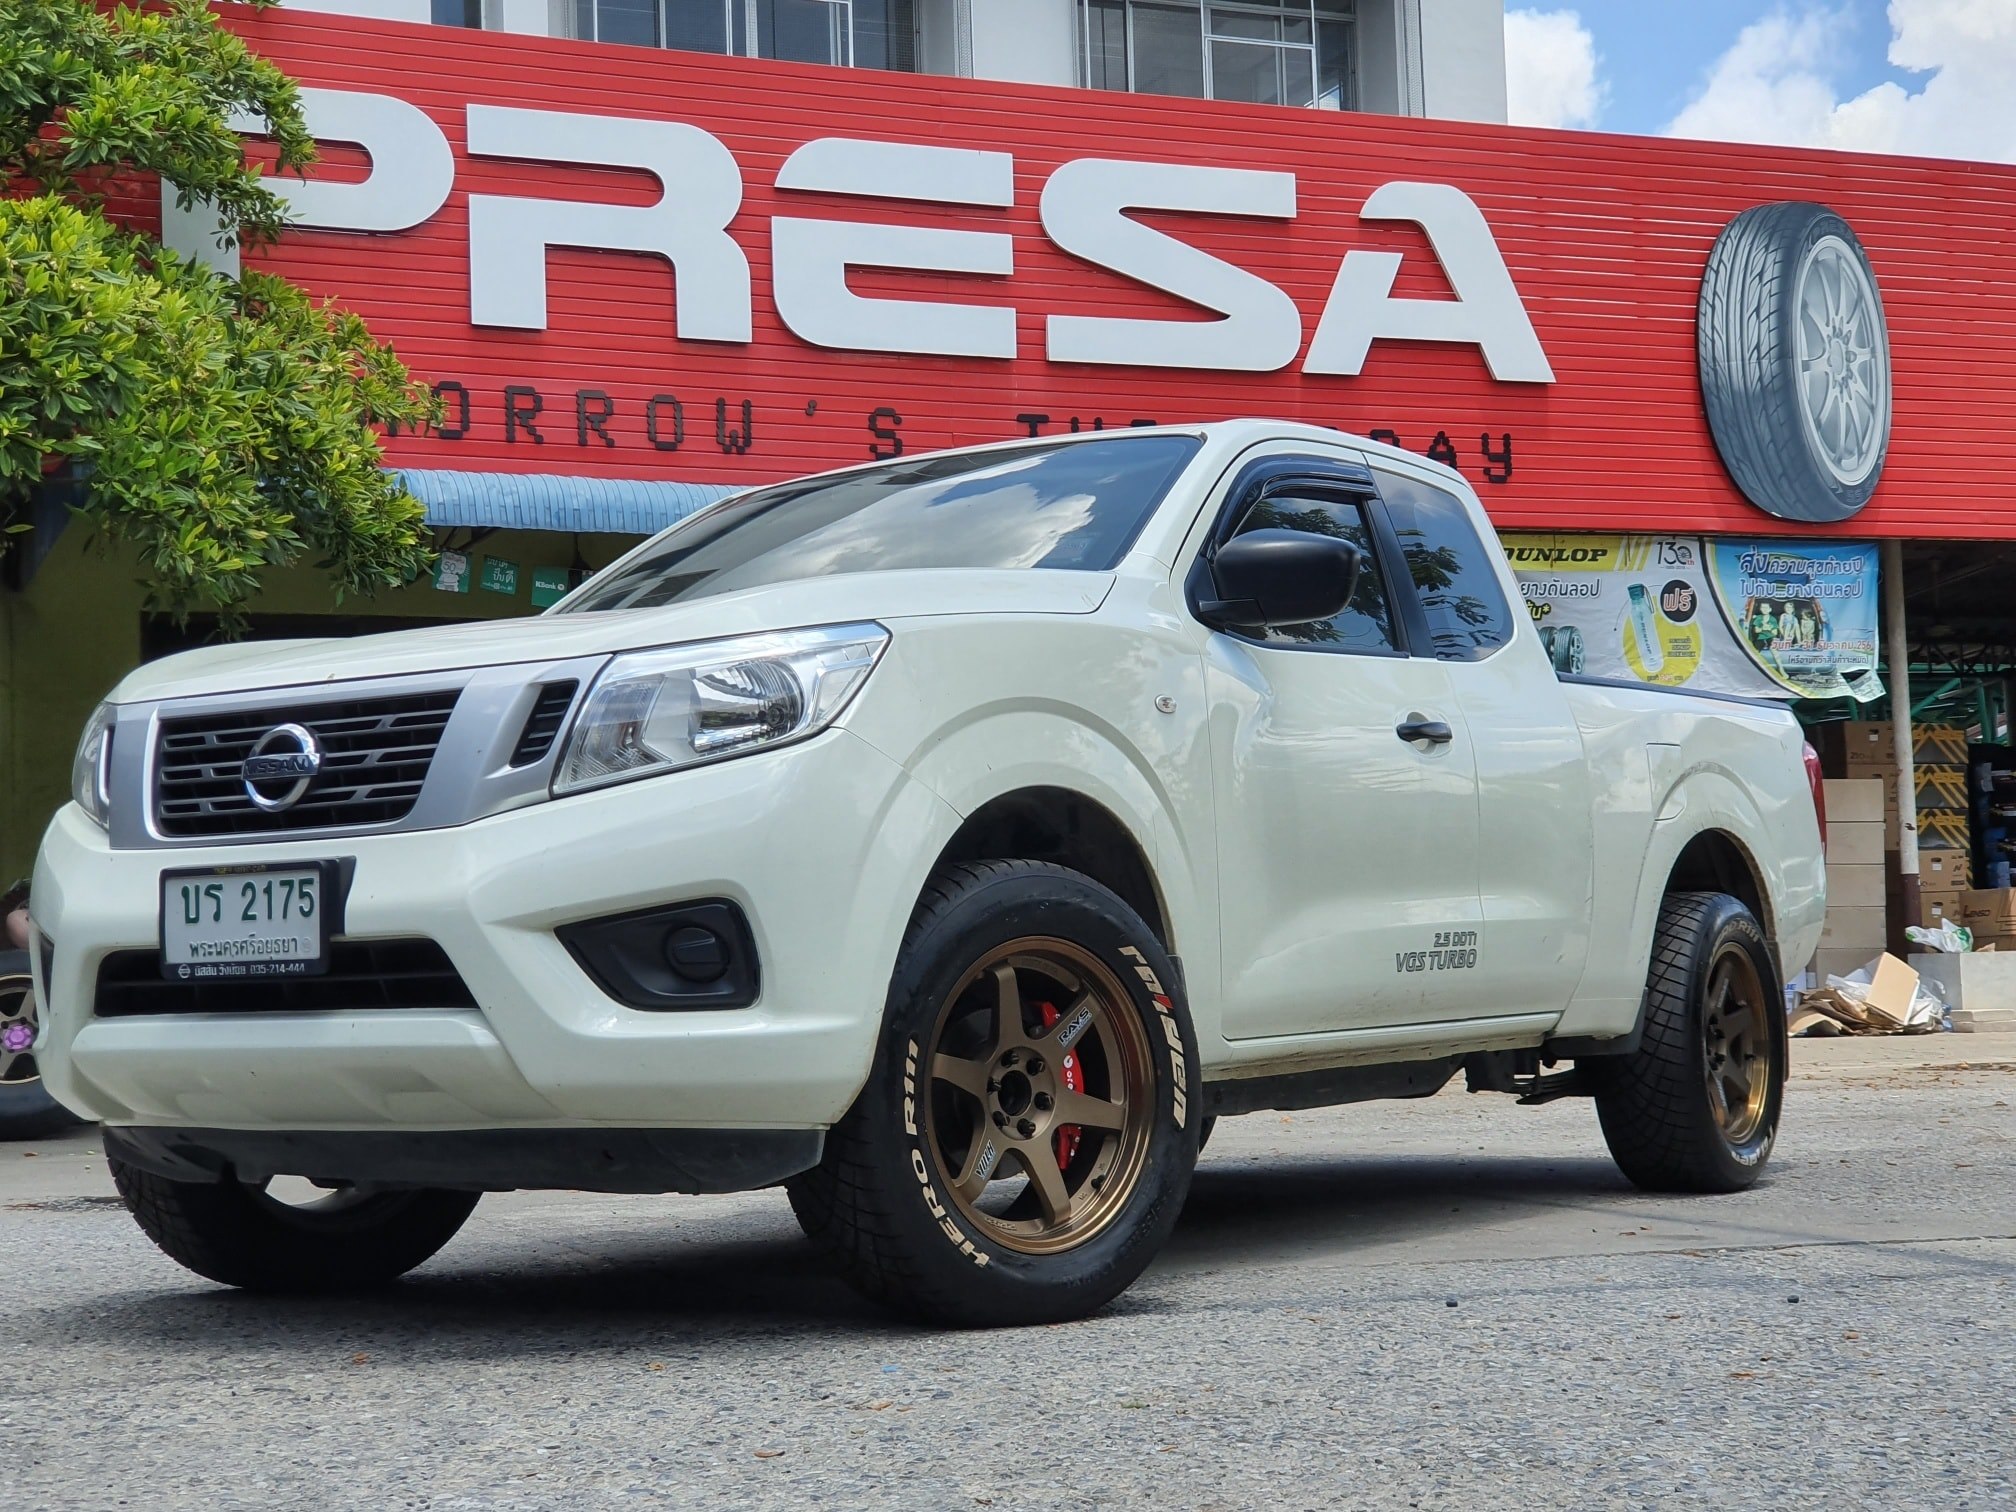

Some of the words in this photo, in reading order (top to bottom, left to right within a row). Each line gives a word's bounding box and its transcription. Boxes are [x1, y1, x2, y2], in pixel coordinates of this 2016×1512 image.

[162, 87, 1556, 384] PRESA
[1663, 588, 1694, 613] ฟรี
[181, 883, 224, 924] บร
[241, 877, 315, 921] 2175
[190, 932, 298, 960] พระนครศรีอยุธยา
[1395, 952, 1427, 972] VGS
[1428, 949, 1478, 970] TURBO
[1058, 1008, 1090, 1043] RAYS
[903, 1038, 920, 1136] R111
[911, 1147, 991, 1269] HERO
